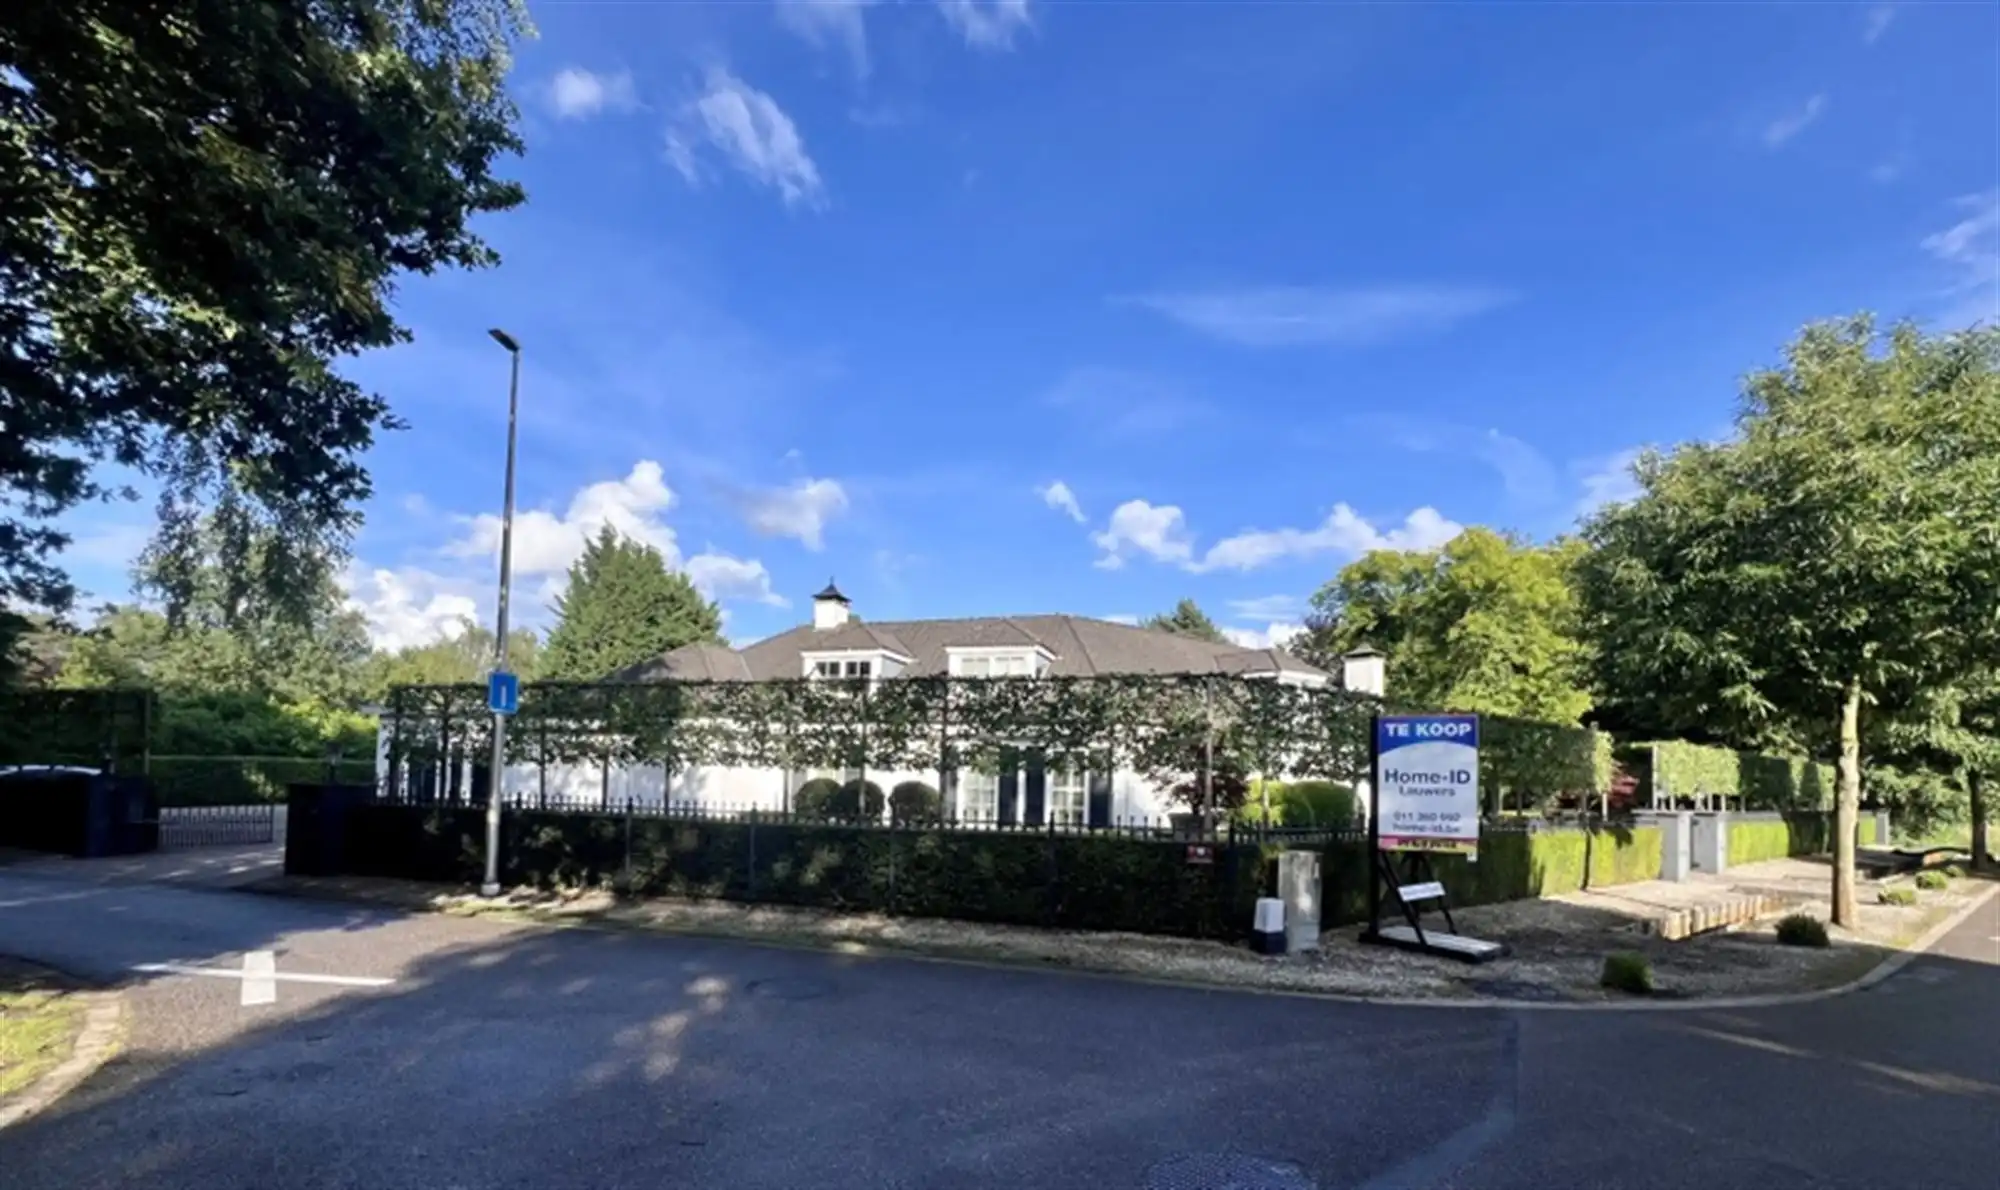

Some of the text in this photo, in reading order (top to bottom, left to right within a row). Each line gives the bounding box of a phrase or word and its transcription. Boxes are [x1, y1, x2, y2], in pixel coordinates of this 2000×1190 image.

[1385, 723, 1472, 736] TE KOOP
[1384, 769, 1471, 784] Home-ID
